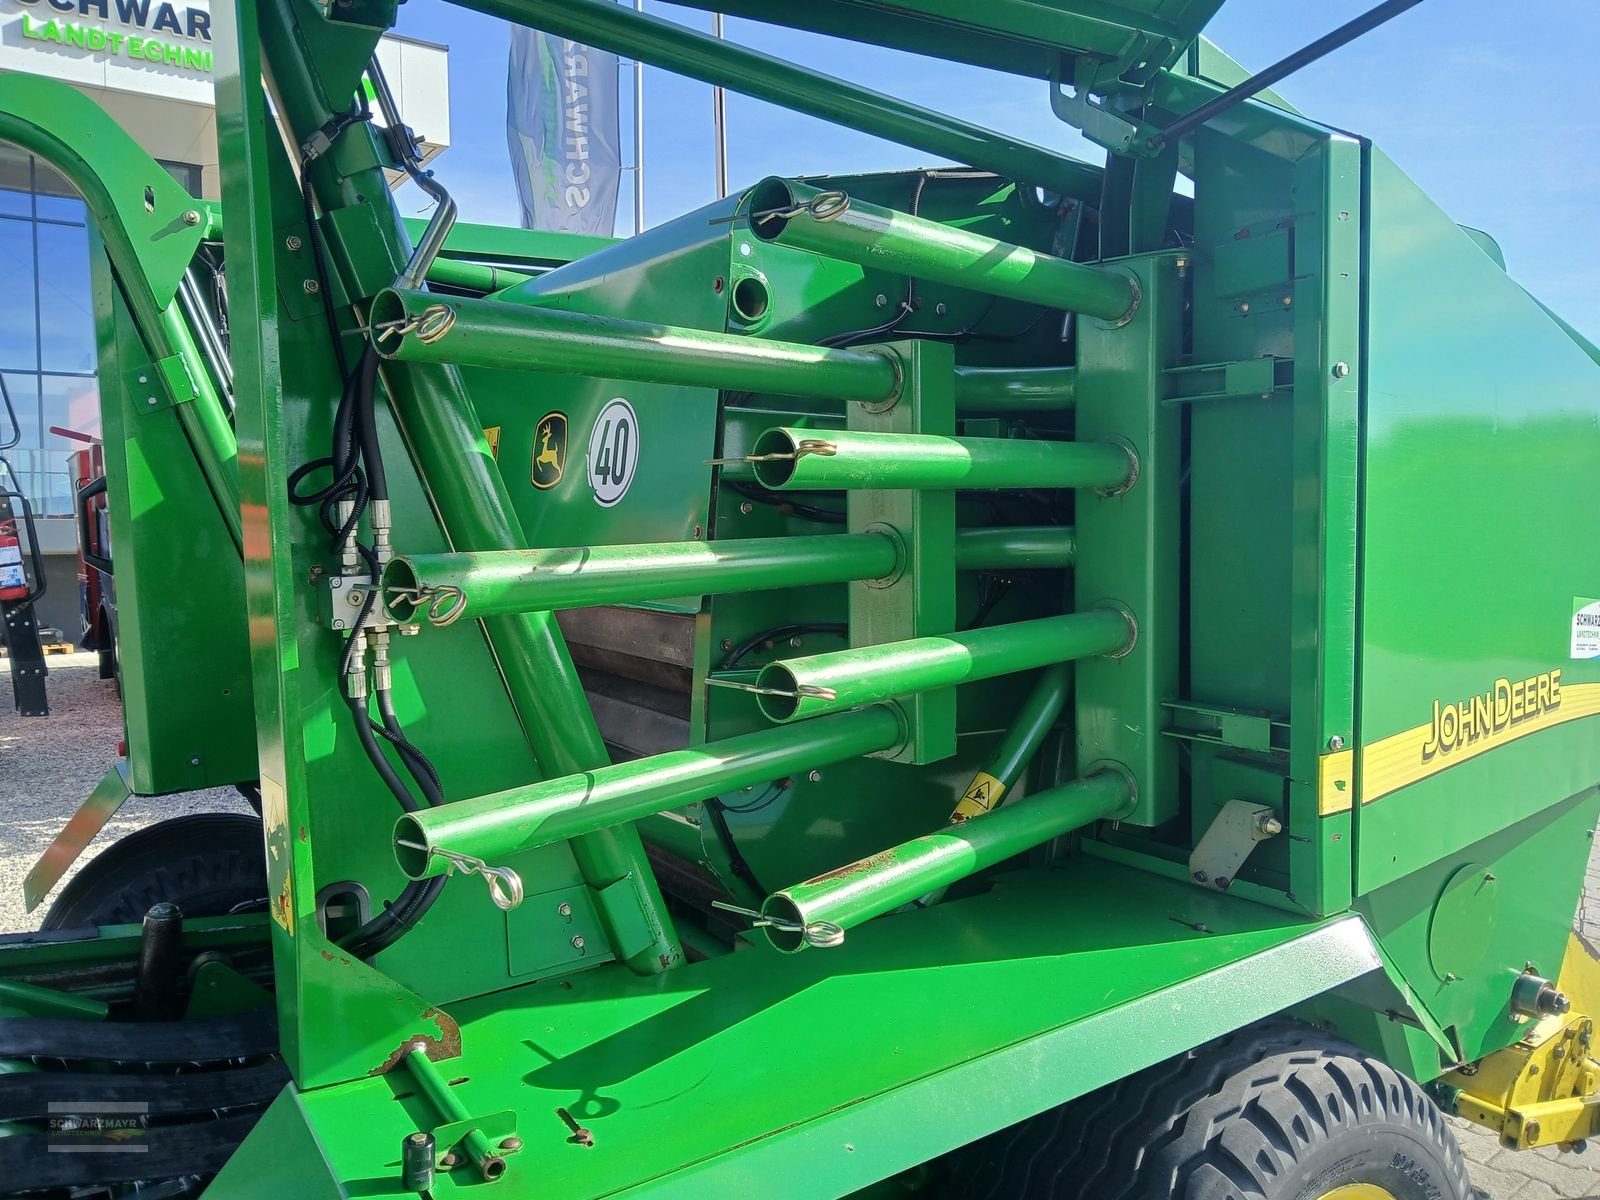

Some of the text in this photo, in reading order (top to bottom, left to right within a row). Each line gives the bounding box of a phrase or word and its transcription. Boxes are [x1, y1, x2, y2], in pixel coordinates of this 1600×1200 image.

[15, 0, 212, 42] HWAR
[594, 418, 630, 486] 40
[1422, 668, 1562, 763] JOHN DEERE
